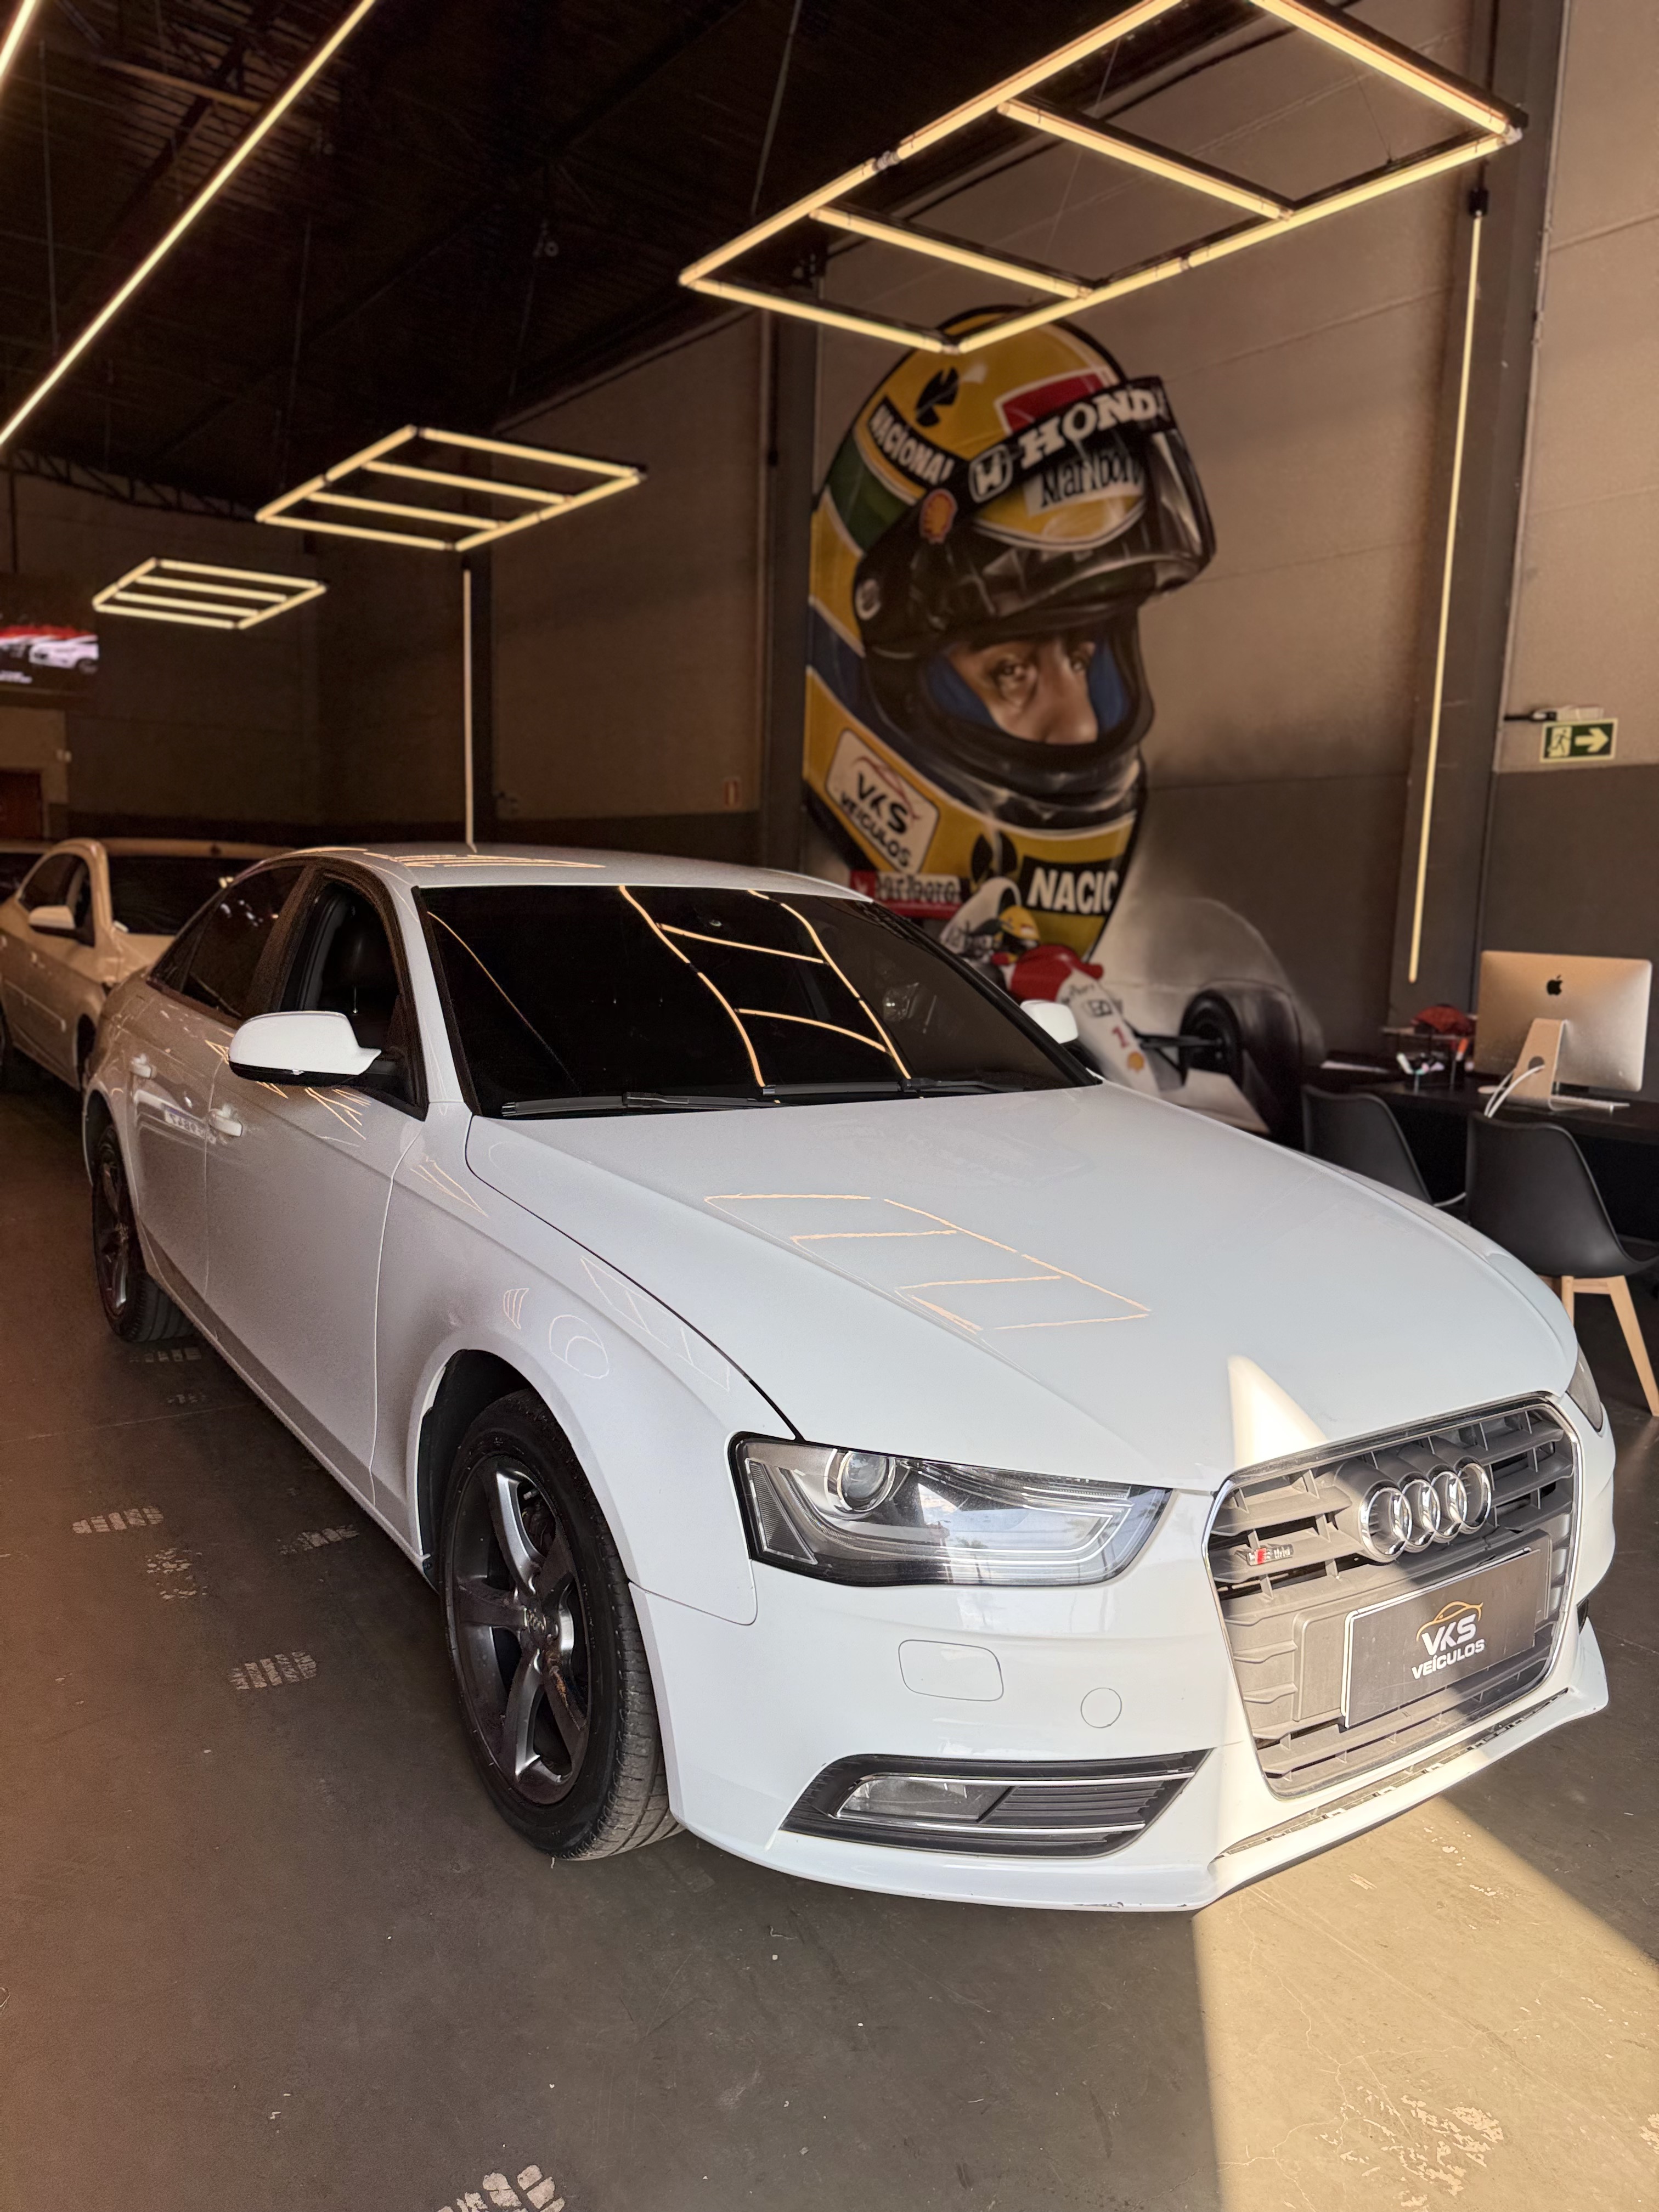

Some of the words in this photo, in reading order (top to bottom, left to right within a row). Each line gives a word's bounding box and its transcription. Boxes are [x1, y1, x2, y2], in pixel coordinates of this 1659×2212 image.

[857, 771, 908, 834] VKS
[1421, 1613, 1476, 1656] VKS
[1411, 1638, 1486, 1680] VEÍCULOS
